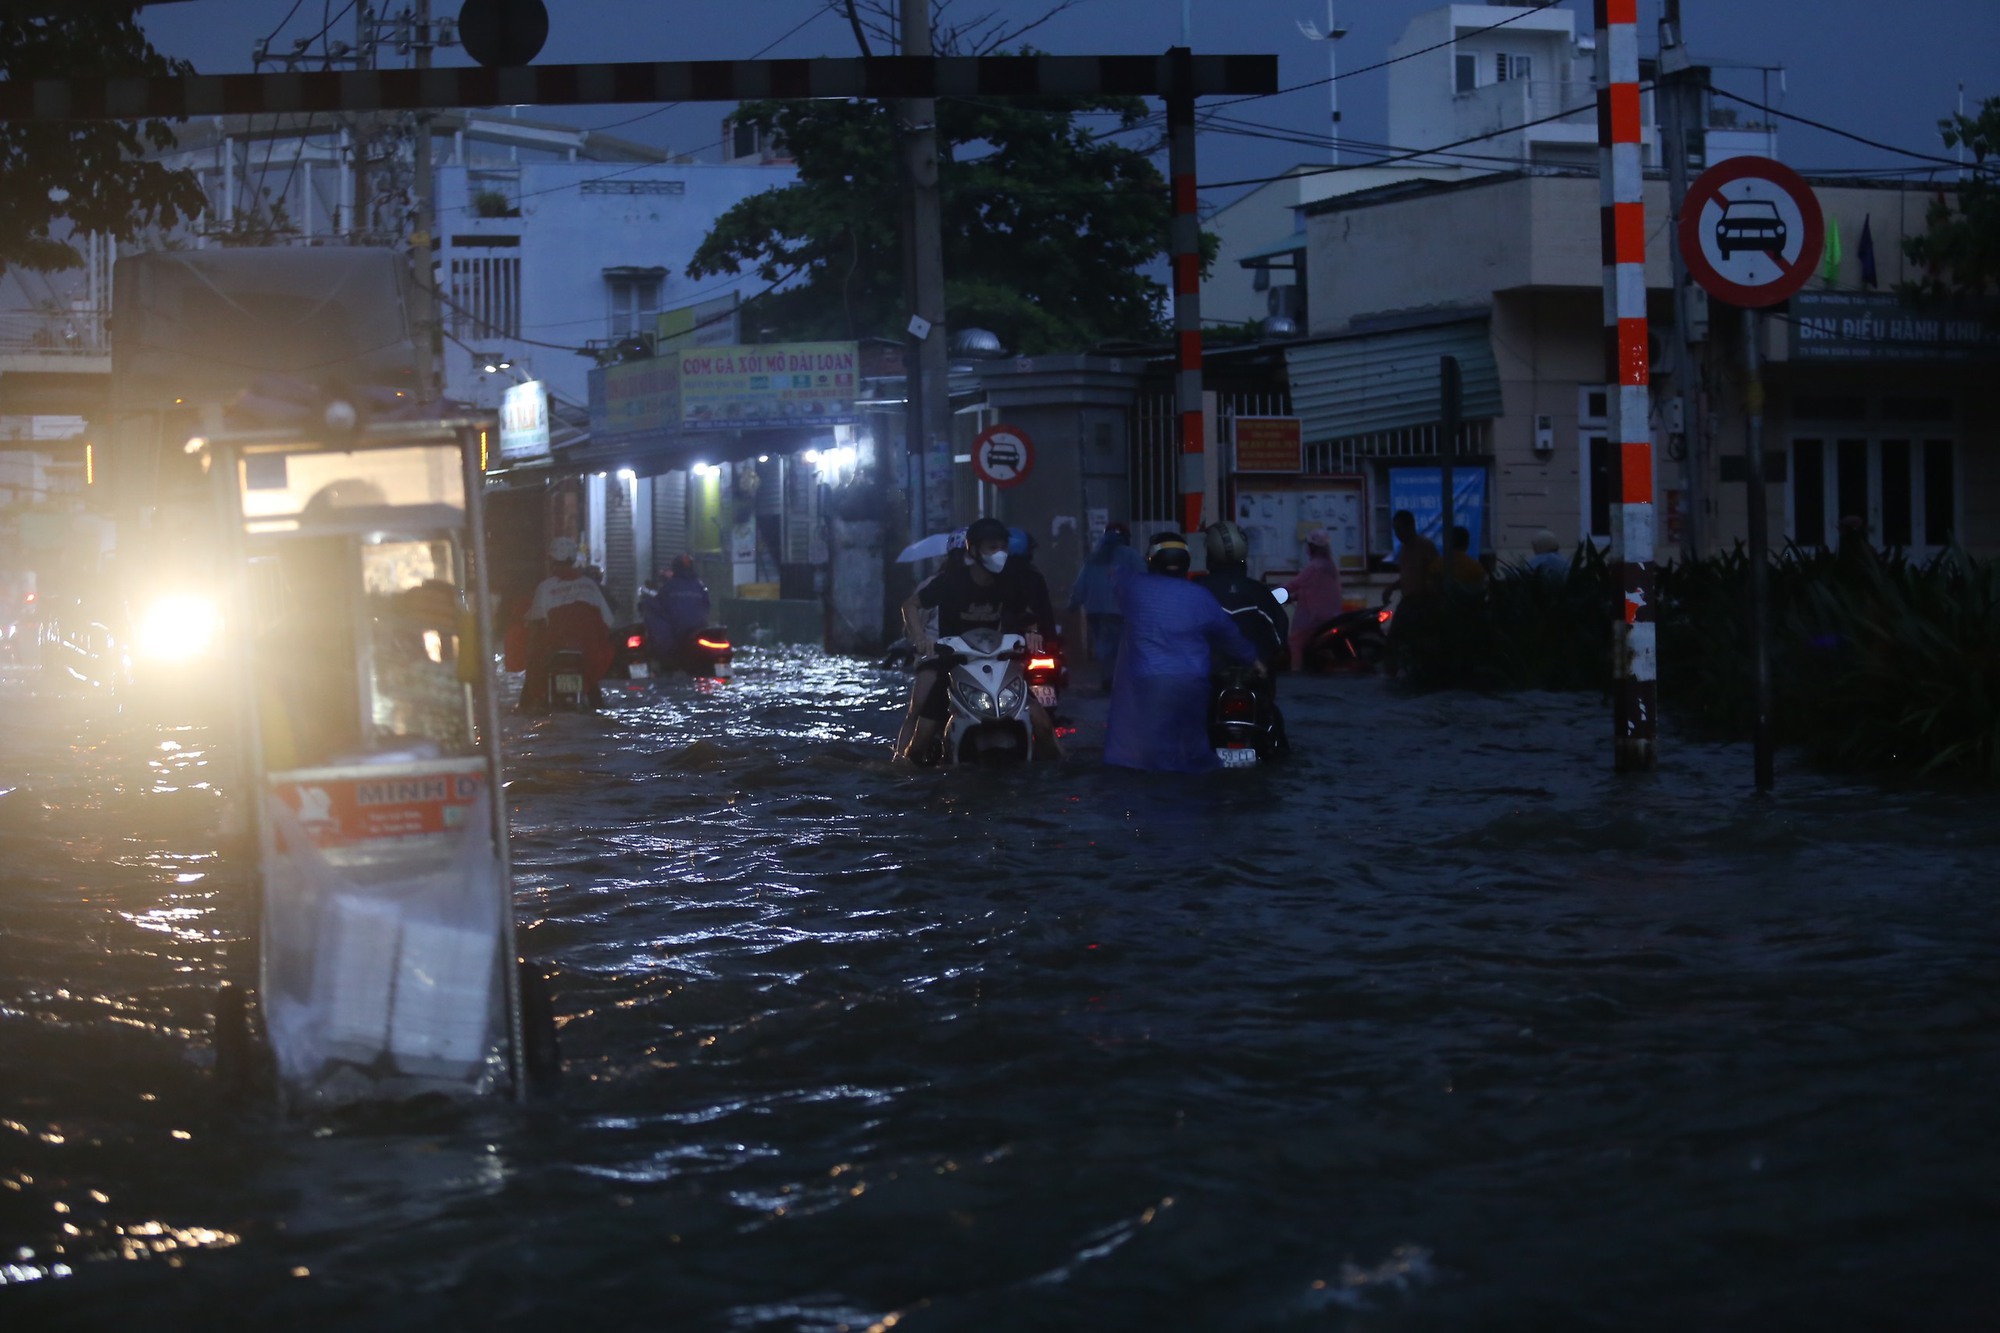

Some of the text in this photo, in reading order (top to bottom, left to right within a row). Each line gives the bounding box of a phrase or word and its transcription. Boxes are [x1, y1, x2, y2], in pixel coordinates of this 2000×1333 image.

[1800, 311, 1981, 342] BAN ĐIỀU HÀNH KHU
[817, 353, 853, 371] LOAN
[358, 779, 445, 805] MINH
